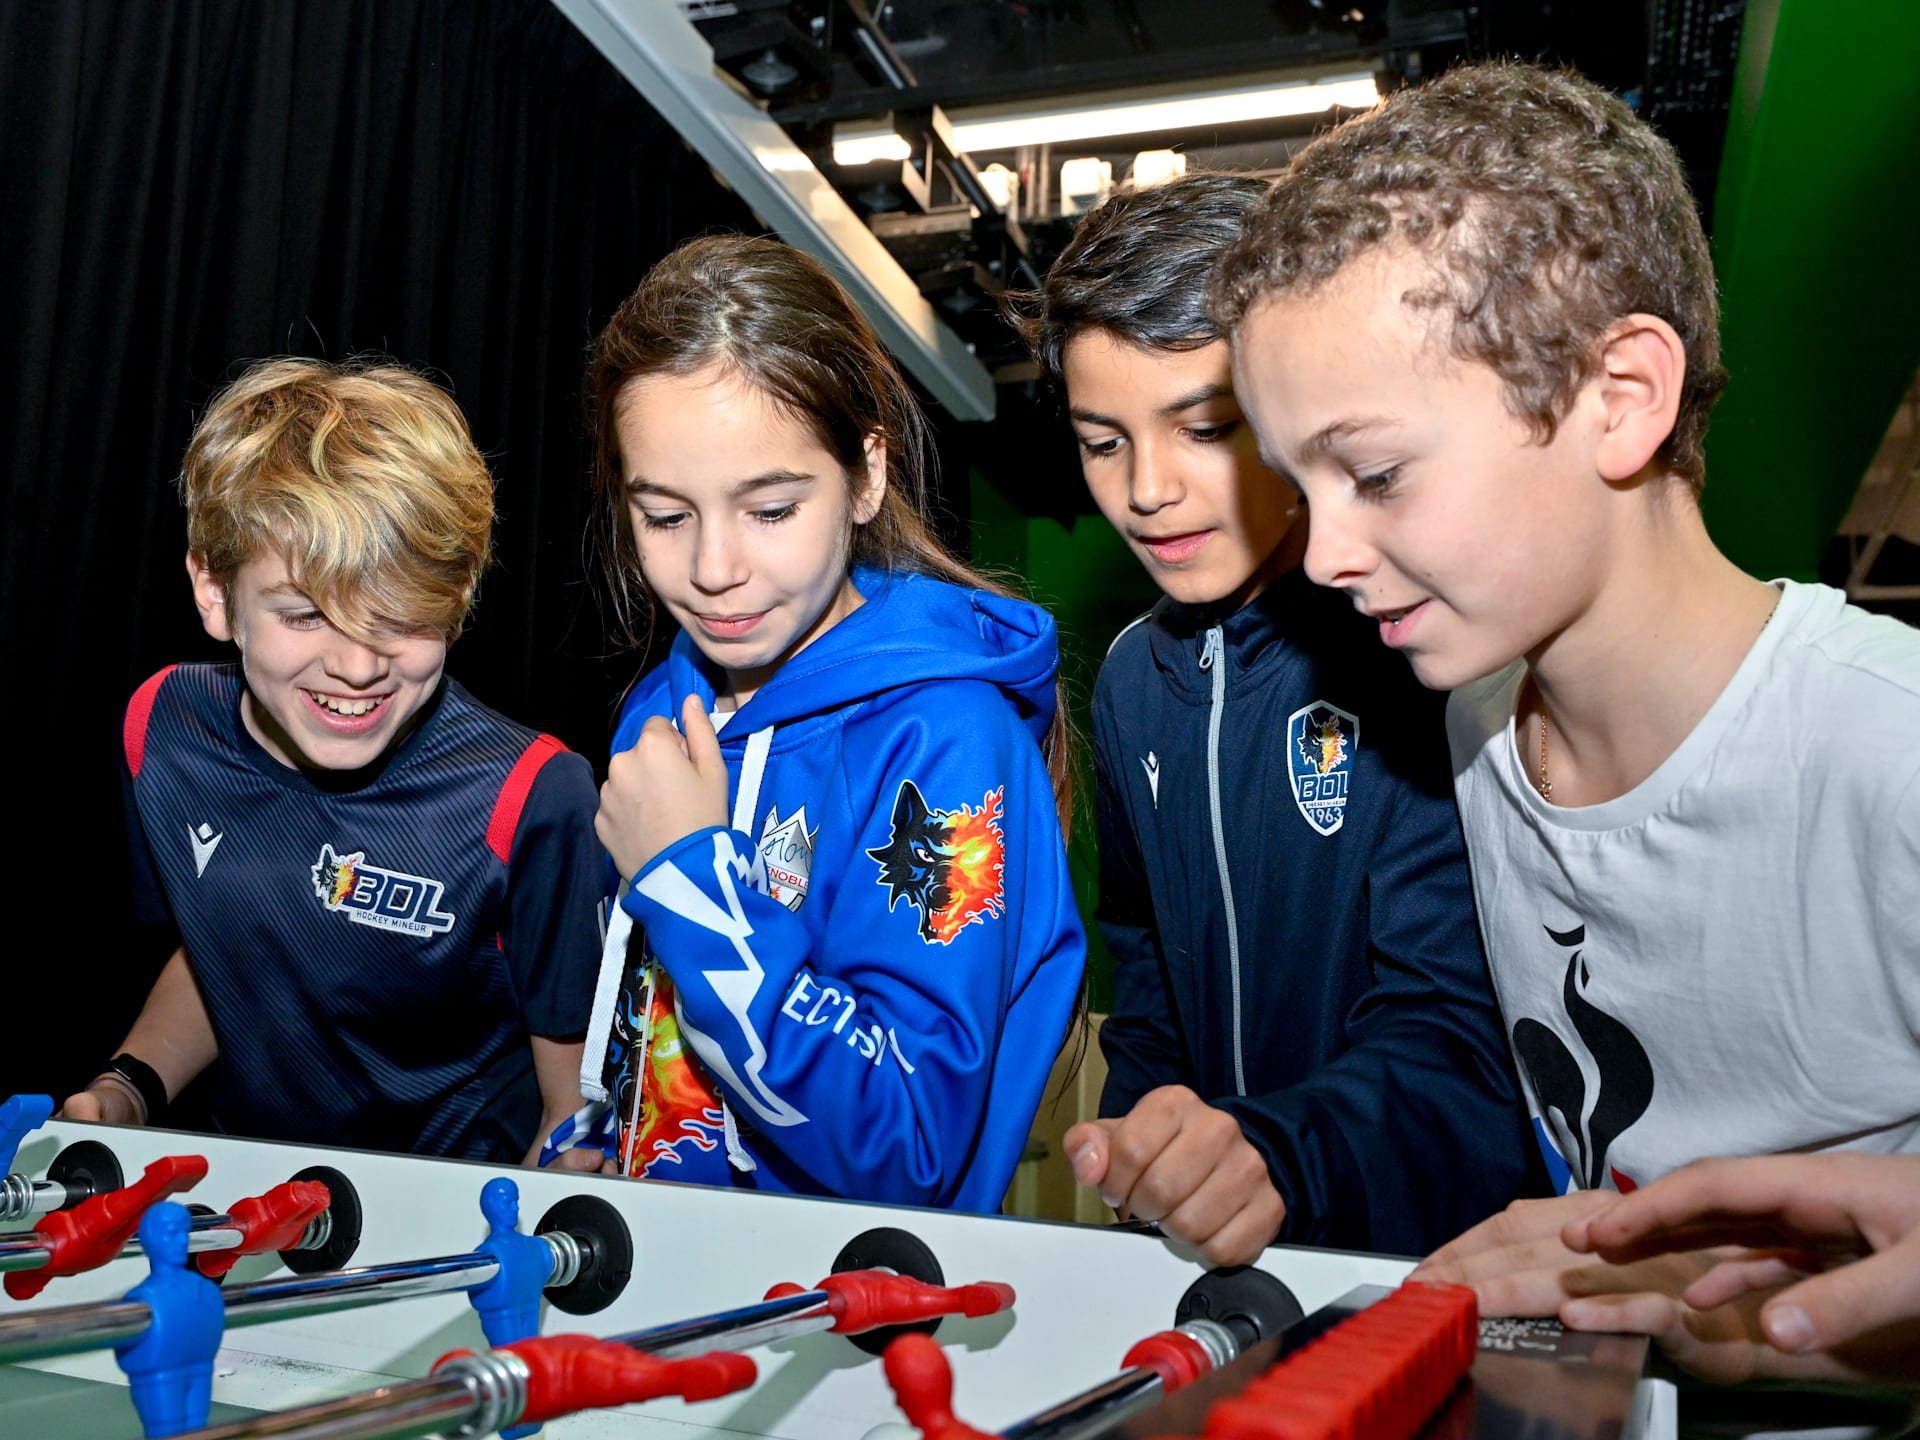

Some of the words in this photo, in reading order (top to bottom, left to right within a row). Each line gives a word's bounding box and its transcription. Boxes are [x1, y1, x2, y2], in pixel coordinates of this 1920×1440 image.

[1309, 807, 1342, 823] 1963
[342, 866, 450, 928] BDL
[356, 910, 388, 924] HOCKEY
[391, 919, 427, 933] MINEUR
